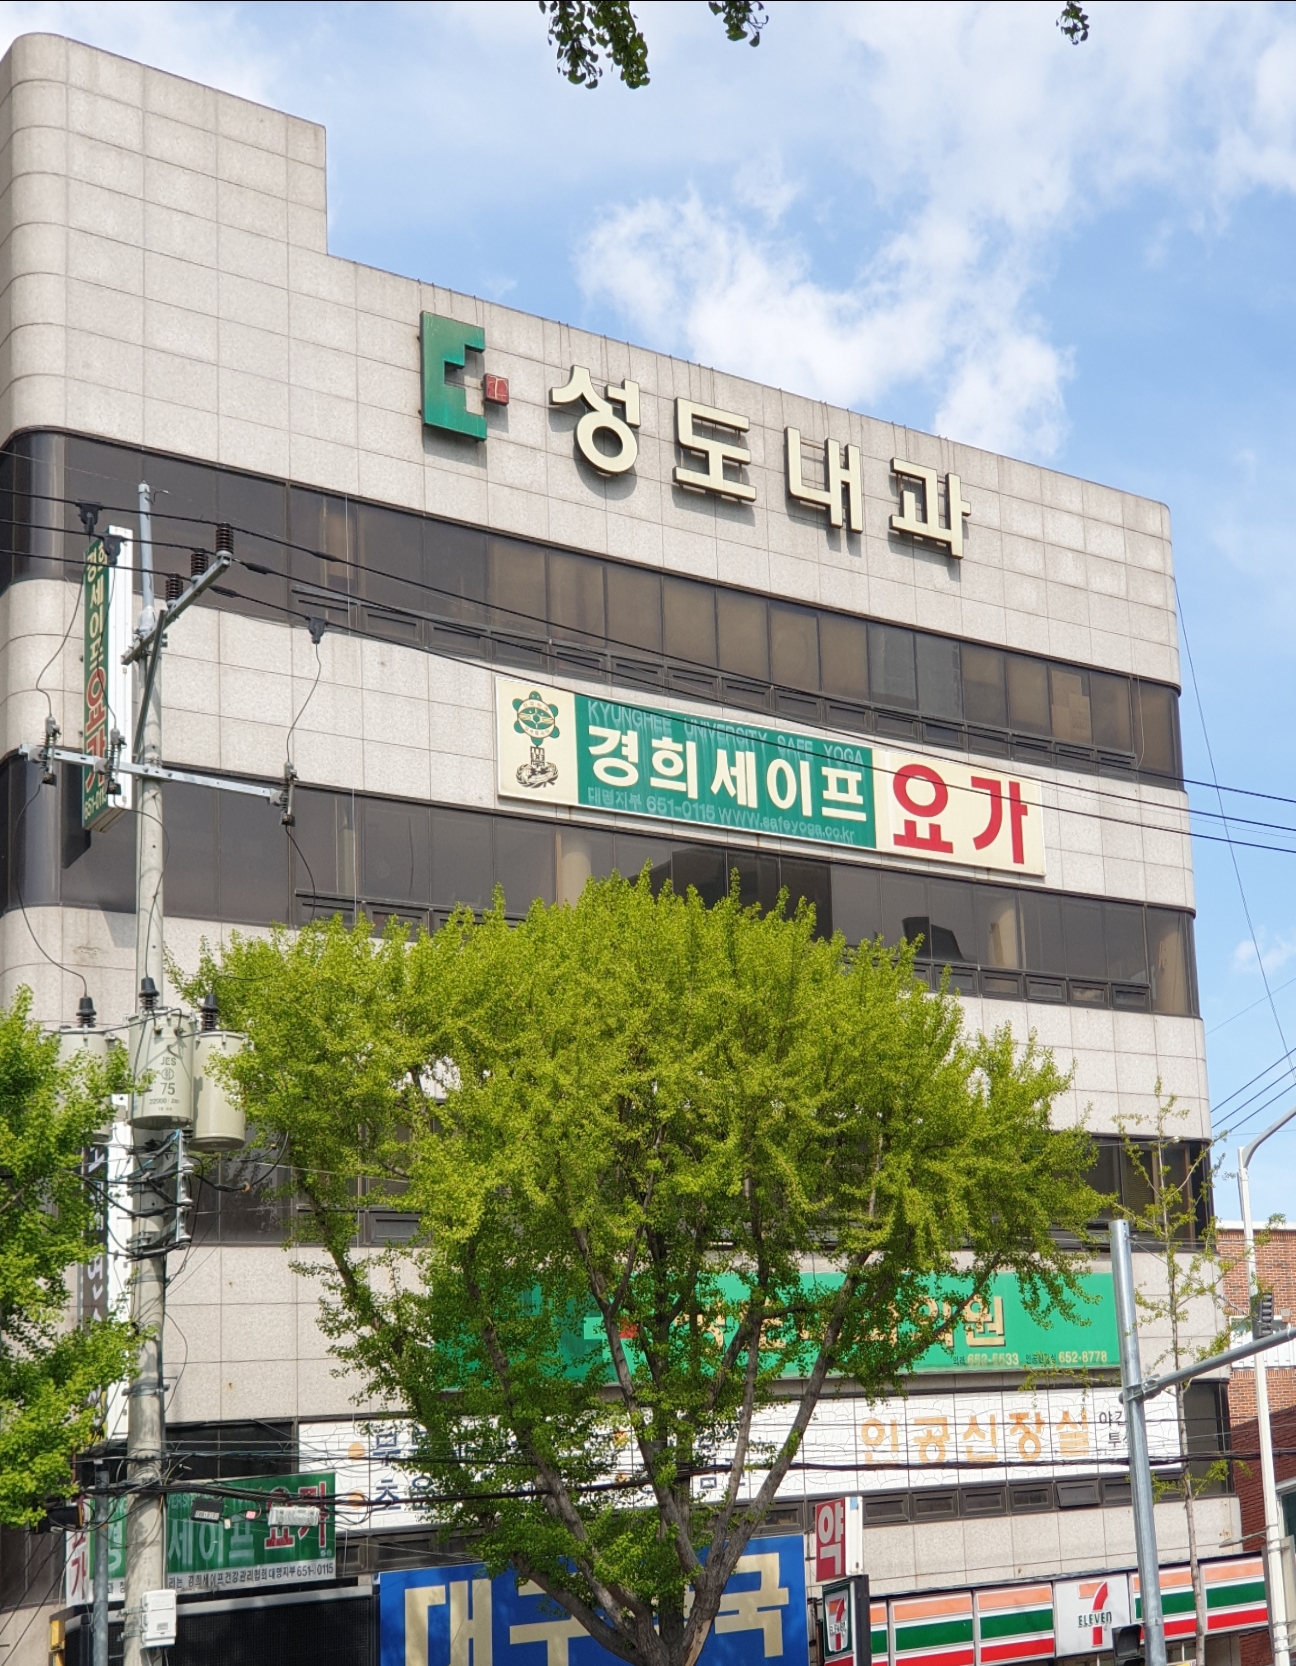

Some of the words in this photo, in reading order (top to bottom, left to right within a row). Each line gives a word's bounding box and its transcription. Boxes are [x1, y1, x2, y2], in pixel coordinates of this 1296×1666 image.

[549, 365, 972, 559] 성도내과
[588, 700, 672, 731] KYUNGHEE
[683, 717, 768, 747] UNIVERSITY
[777, 735, 814, 760] SAFE
[822, 743, 864, 768] YOGA
[587, 787, 641, 812] 대명지부
[646, 796, 716, 821] 651-0115
[588, 725, 867, 822] 경희세이프
[892, 763, 1029, 866] 요가
[160, 1082, 176, 1096] 75
[968, 1352, 1020, 1367] 652-5533
[1058, 1350, 1108, 1364] 652-8778
[860, 1408, 1091, 1465] 인공신장실
[817, 1501, 844, 1576] 약
